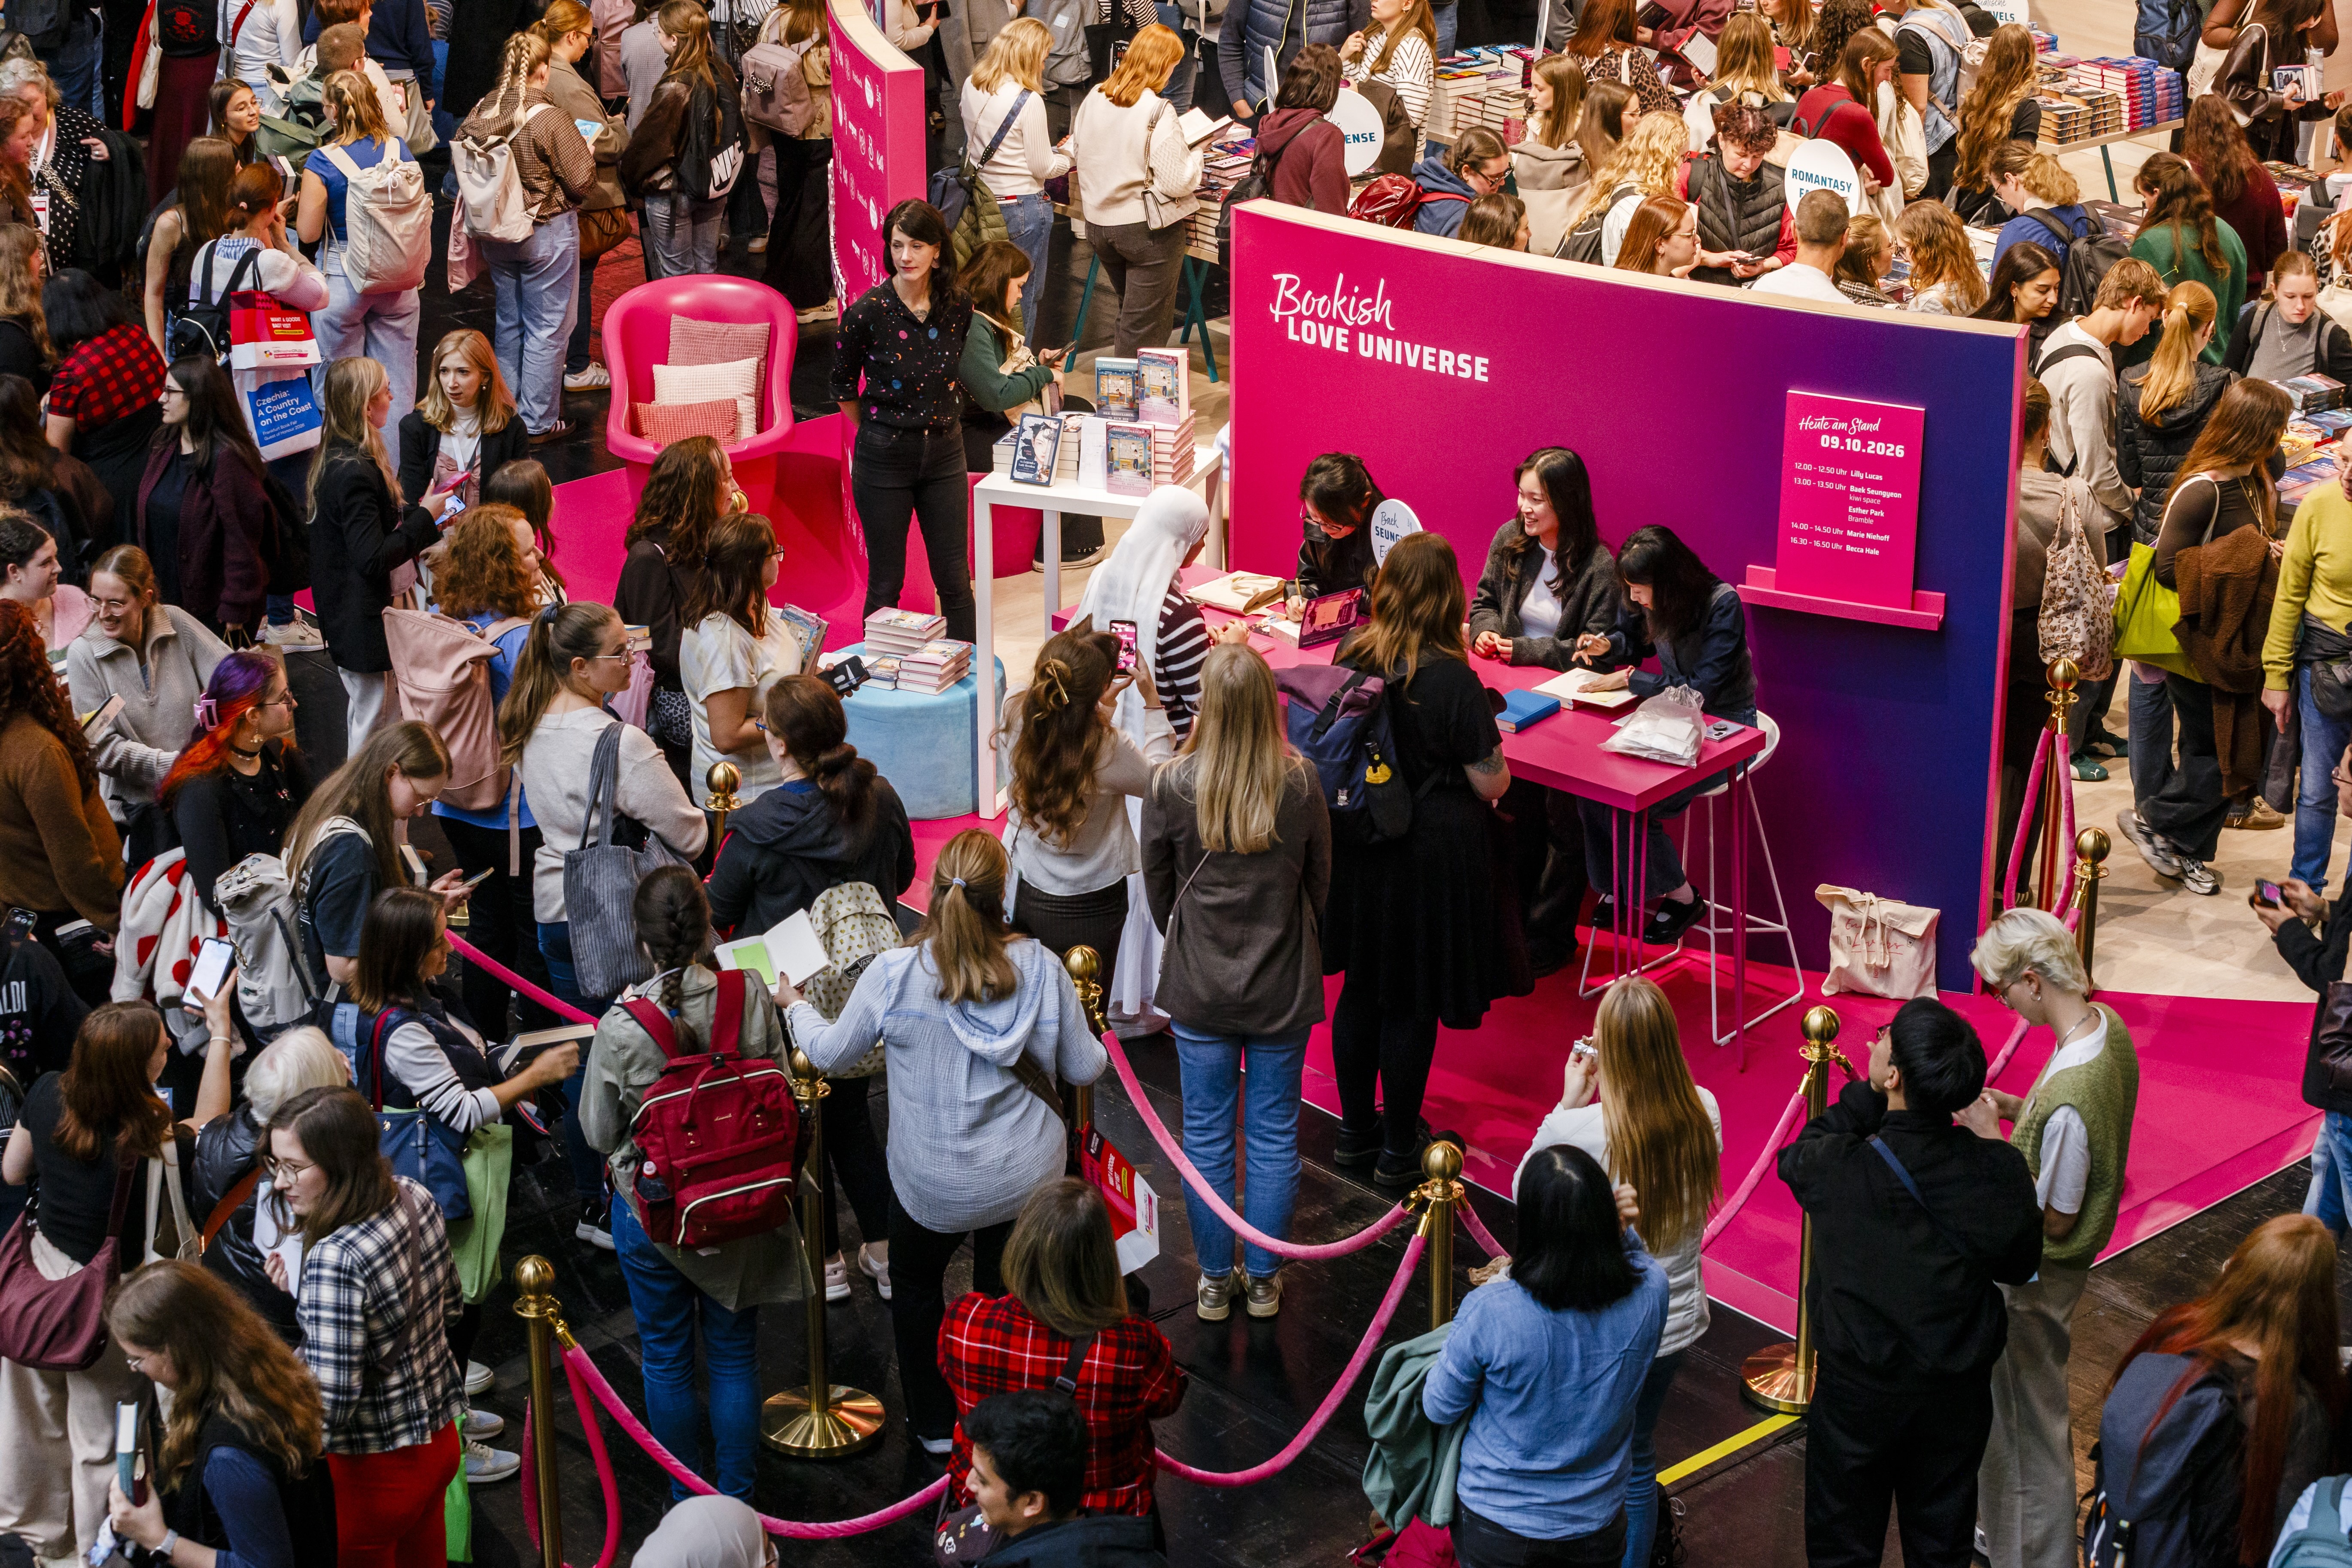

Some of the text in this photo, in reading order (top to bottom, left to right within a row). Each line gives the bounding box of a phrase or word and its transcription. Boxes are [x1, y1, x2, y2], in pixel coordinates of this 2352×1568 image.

[1989, 10, 2015, 22] VELS
[1792, 168, 1852, 192] ROMANTASY
[1269, 272, 1396, 331] Bookish
[1287, 316, 1489, 382] LOVE UNIVERSE
[256, 390, 290, 407] Czechia:
[258, 397, 299, 417] A Country
[273, 412, 288, 421] the
[289, 402, 312, 415] Coast
[1798, 415, 1881, 435] Heute am Stand
[1820, 434, 1905, 457] 09.10.2026
[1795, 463, 1812, 471] 12.00
[1818, 466, 1835, 474] 12.50
[1850, 470, 1864, 479] Lilly
[1865, 472, 1883, 481] Lucas
[1794, 478, 1811, 486] 13.00
[1817, 481, 1834, 489] 13.50
[1850, 485, 1865, 493] Baek
[1867, 488, 1902, 498] Seungyeon
[1849, 494, 1881, 505] kiwi space
[1381, 512, 1399, 528] Baek
[1848, 506, 1884, 517] Esther Park
[1848, 515, 1874, 524] Bramble
[1791, 522, 1808, 530] 14.00
[1814, 525, 1831, 533] 14.50
[1847, 530, 1865, 538] Marie
[1866, 533, 1890, 542] Niehoff
[1790, 537, 1807, 545] 16.30
[1813, 540, 1830, 548] 16.50
[1846, 545, 1864, 553] Becca
[1865, 547, 1879, 555] Hale
[1847, 936, 1851, 945] TO
